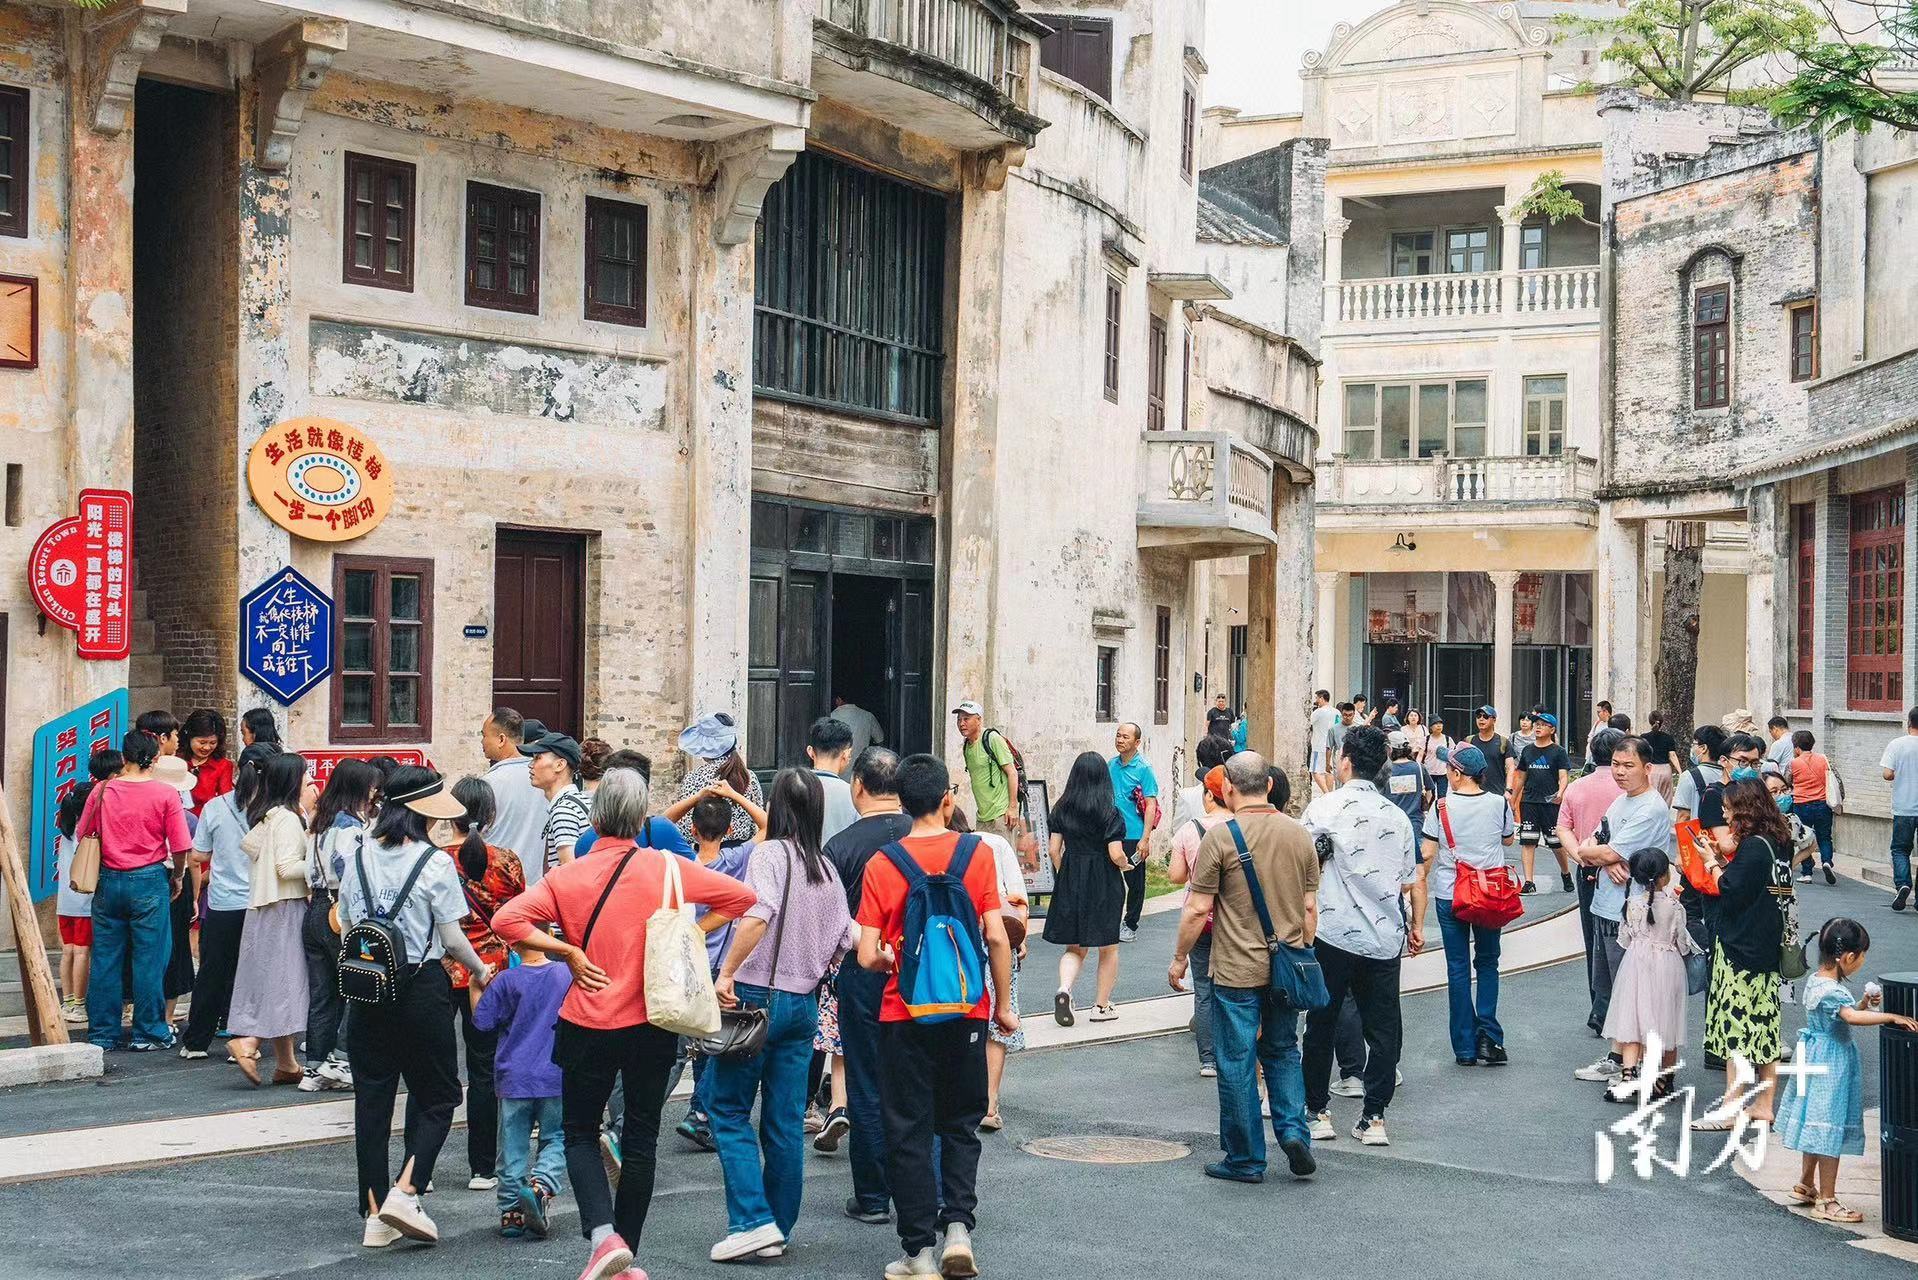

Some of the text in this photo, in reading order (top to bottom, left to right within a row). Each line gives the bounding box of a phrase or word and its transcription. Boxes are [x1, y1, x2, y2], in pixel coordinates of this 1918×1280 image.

[265, 426, 382, 480] 生活就像楼梯
[273, 491, 375, 531] 一步一个脚印
[37, 526, 78, 621] Chikan Resort Town
[85, 504, 103, 643] 阳光一直都在盛开
[106, 530, 124, 618] 楼梯的尽头
[265, 587, 303, 609] 人生
[255, 622, 315, 644] 不一定非得
[272, 637, 308, 655] 向上
